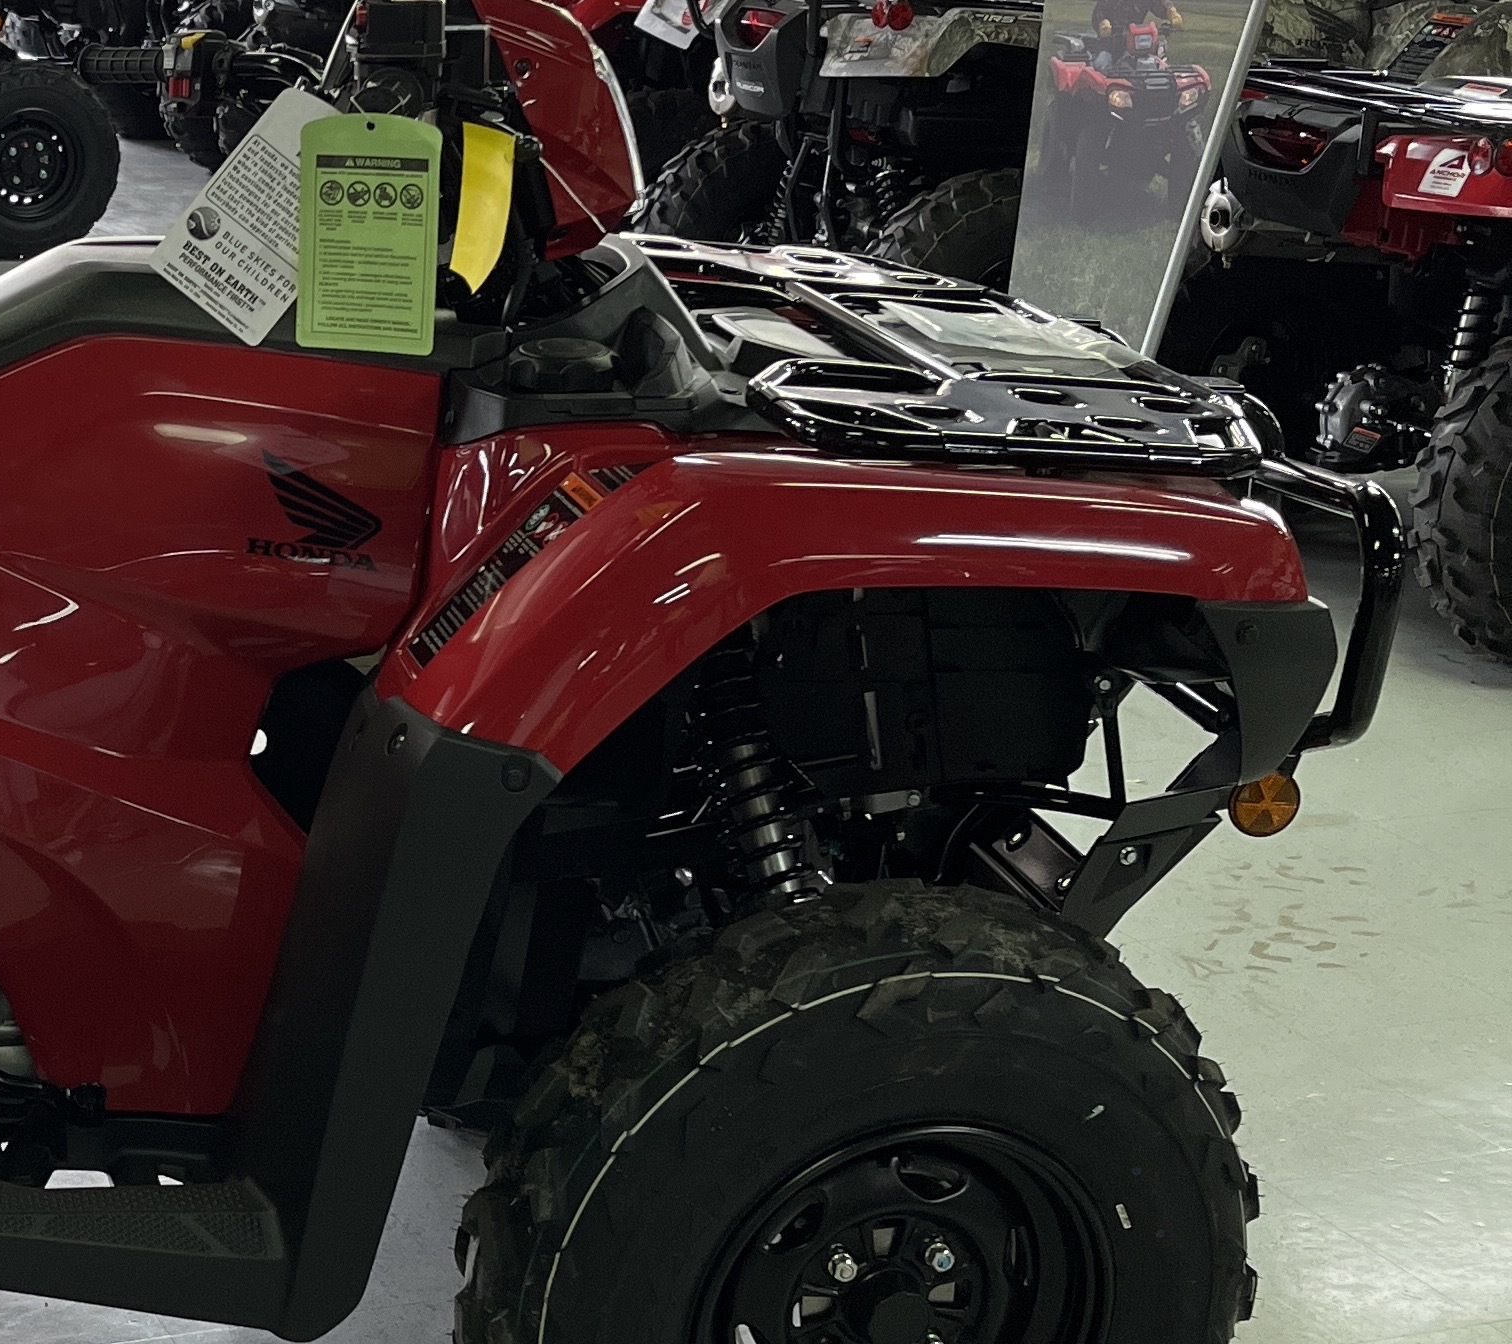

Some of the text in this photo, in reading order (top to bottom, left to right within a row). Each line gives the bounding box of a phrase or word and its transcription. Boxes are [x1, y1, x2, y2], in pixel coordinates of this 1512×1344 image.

[355, 158, 402, 168] WARNING
[177, 251, 228, 294] PERFORMANCE
[181, 239, 211, 266] BEST
[208, 261, 226, 278] ON
[213, 240, 237, 261] OUR
[236, 258, 289, 303] CHILDREN
[221, 230, 248, 254] BLUE
[246, 250, 277, 277] SKIES
[275, 273, 297, 294] FOR
[245, 537, 377, 572] HONDA
